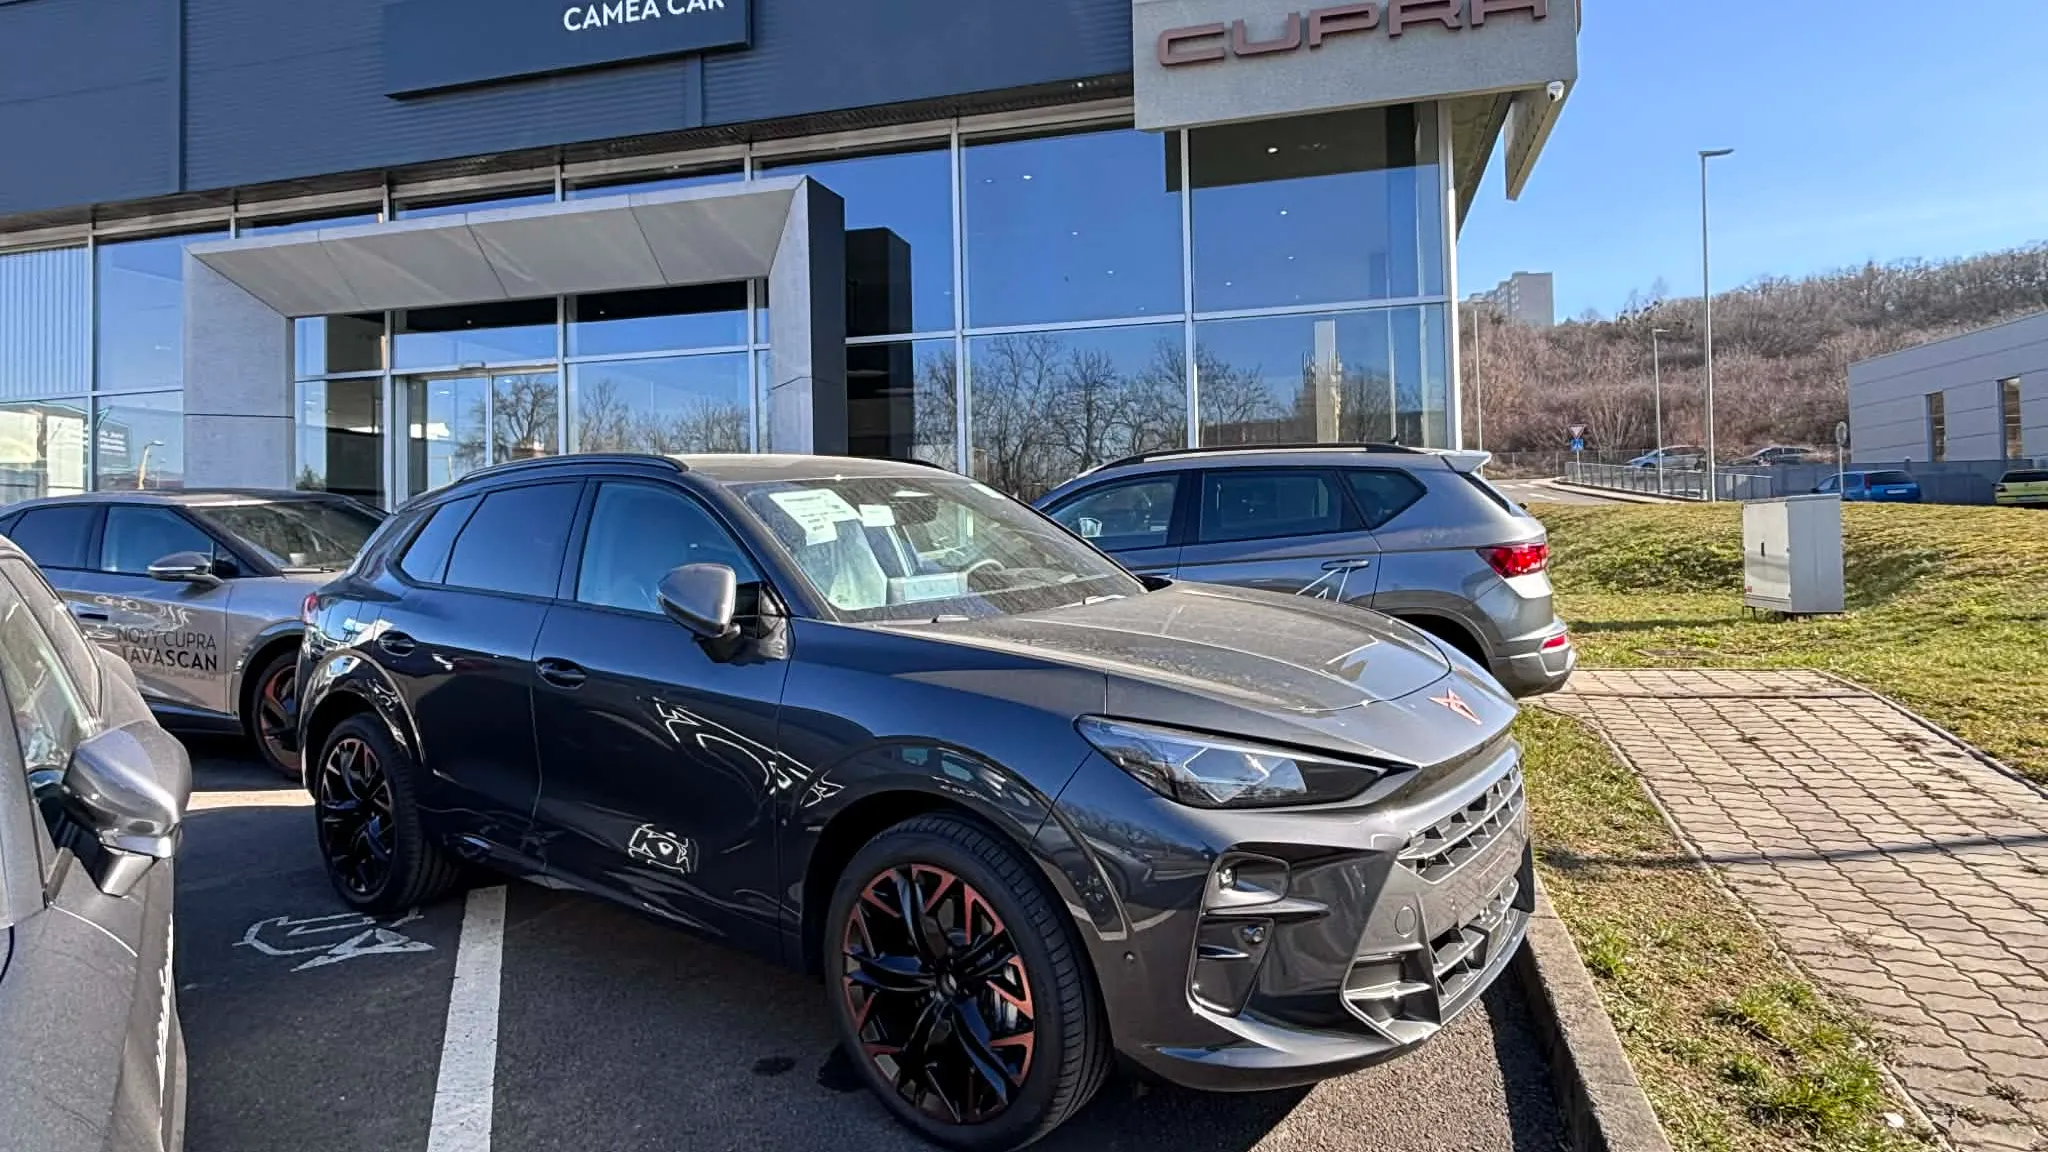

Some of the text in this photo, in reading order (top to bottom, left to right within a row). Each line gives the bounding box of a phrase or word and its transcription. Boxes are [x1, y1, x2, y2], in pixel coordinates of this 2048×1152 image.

[563, 0, 661, 32] CAMEA
[1157, 0, 1547, 67] CUPRA
[163, 630, 217, 651] CUPRA
[121, 645, 217, 671] TAVASCAN
